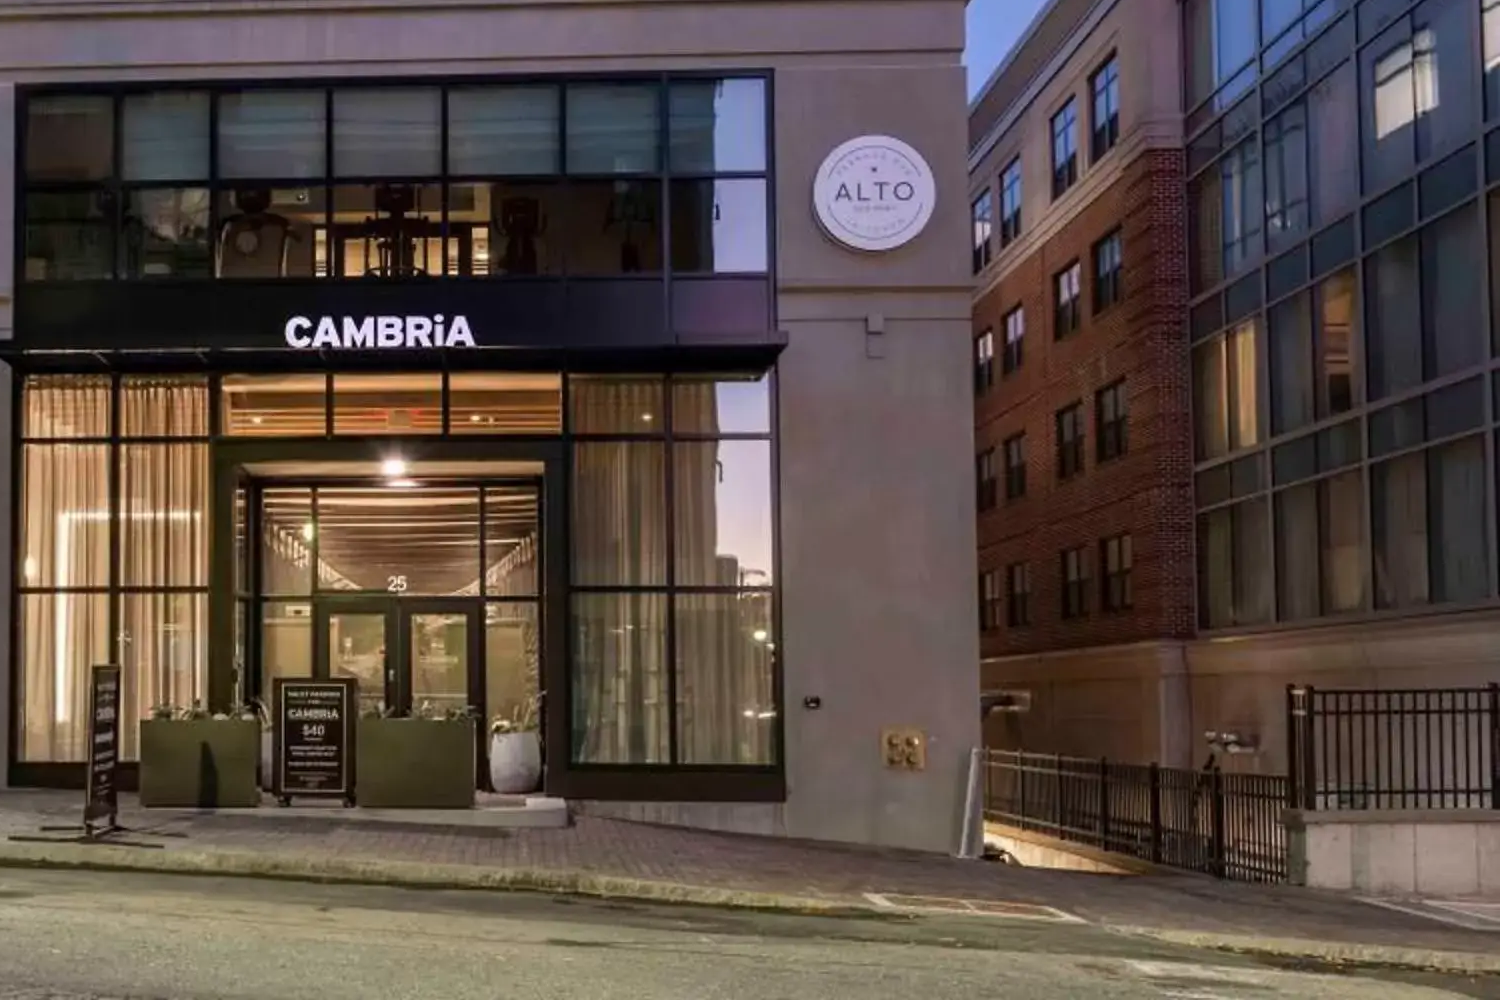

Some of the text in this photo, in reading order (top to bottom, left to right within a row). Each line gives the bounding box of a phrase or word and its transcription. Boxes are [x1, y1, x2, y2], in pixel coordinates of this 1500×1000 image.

[835, 181, 914, 201] ALTO
[284, 313, 476, 348] CAMBRiA
[387, 575, 407, 591] 25
